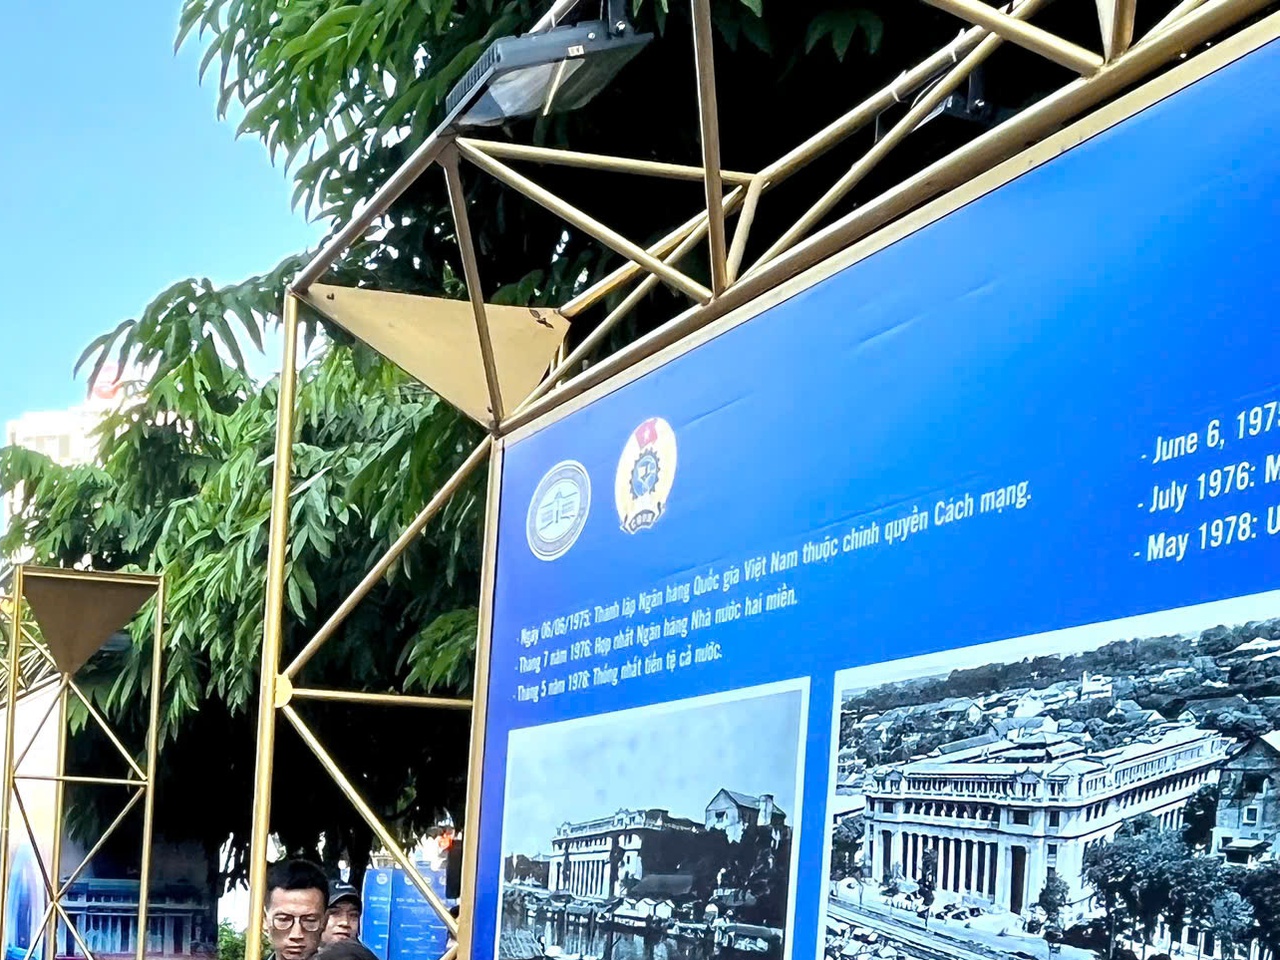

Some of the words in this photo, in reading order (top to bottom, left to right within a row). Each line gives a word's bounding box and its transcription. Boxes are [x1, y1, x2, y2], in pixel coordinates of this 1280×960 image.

[1152, 432, 1198, 465] June
[1206, 419, 1225, 449] 6,
[1237, 401, 1280, 439] 197
[1149, 480, 1188, 514] July
[1197, 461, 1256, 500] 1976:
[722, 565, 740, 592] gia
[744, 557, 767, 582] Việt
[770, 550, 798, 574] Nam
[802, 536, 838, 564] thuộc
[884, 505, 928, 545] quyền
[934, 497, 973, 526] Cách
[980, 480, 1032, 514] mạng.
[1147, 532, 1189, 562] May
[1199, 512, 1258, 550] 1978:
[744, 592, 762, 616] hai
